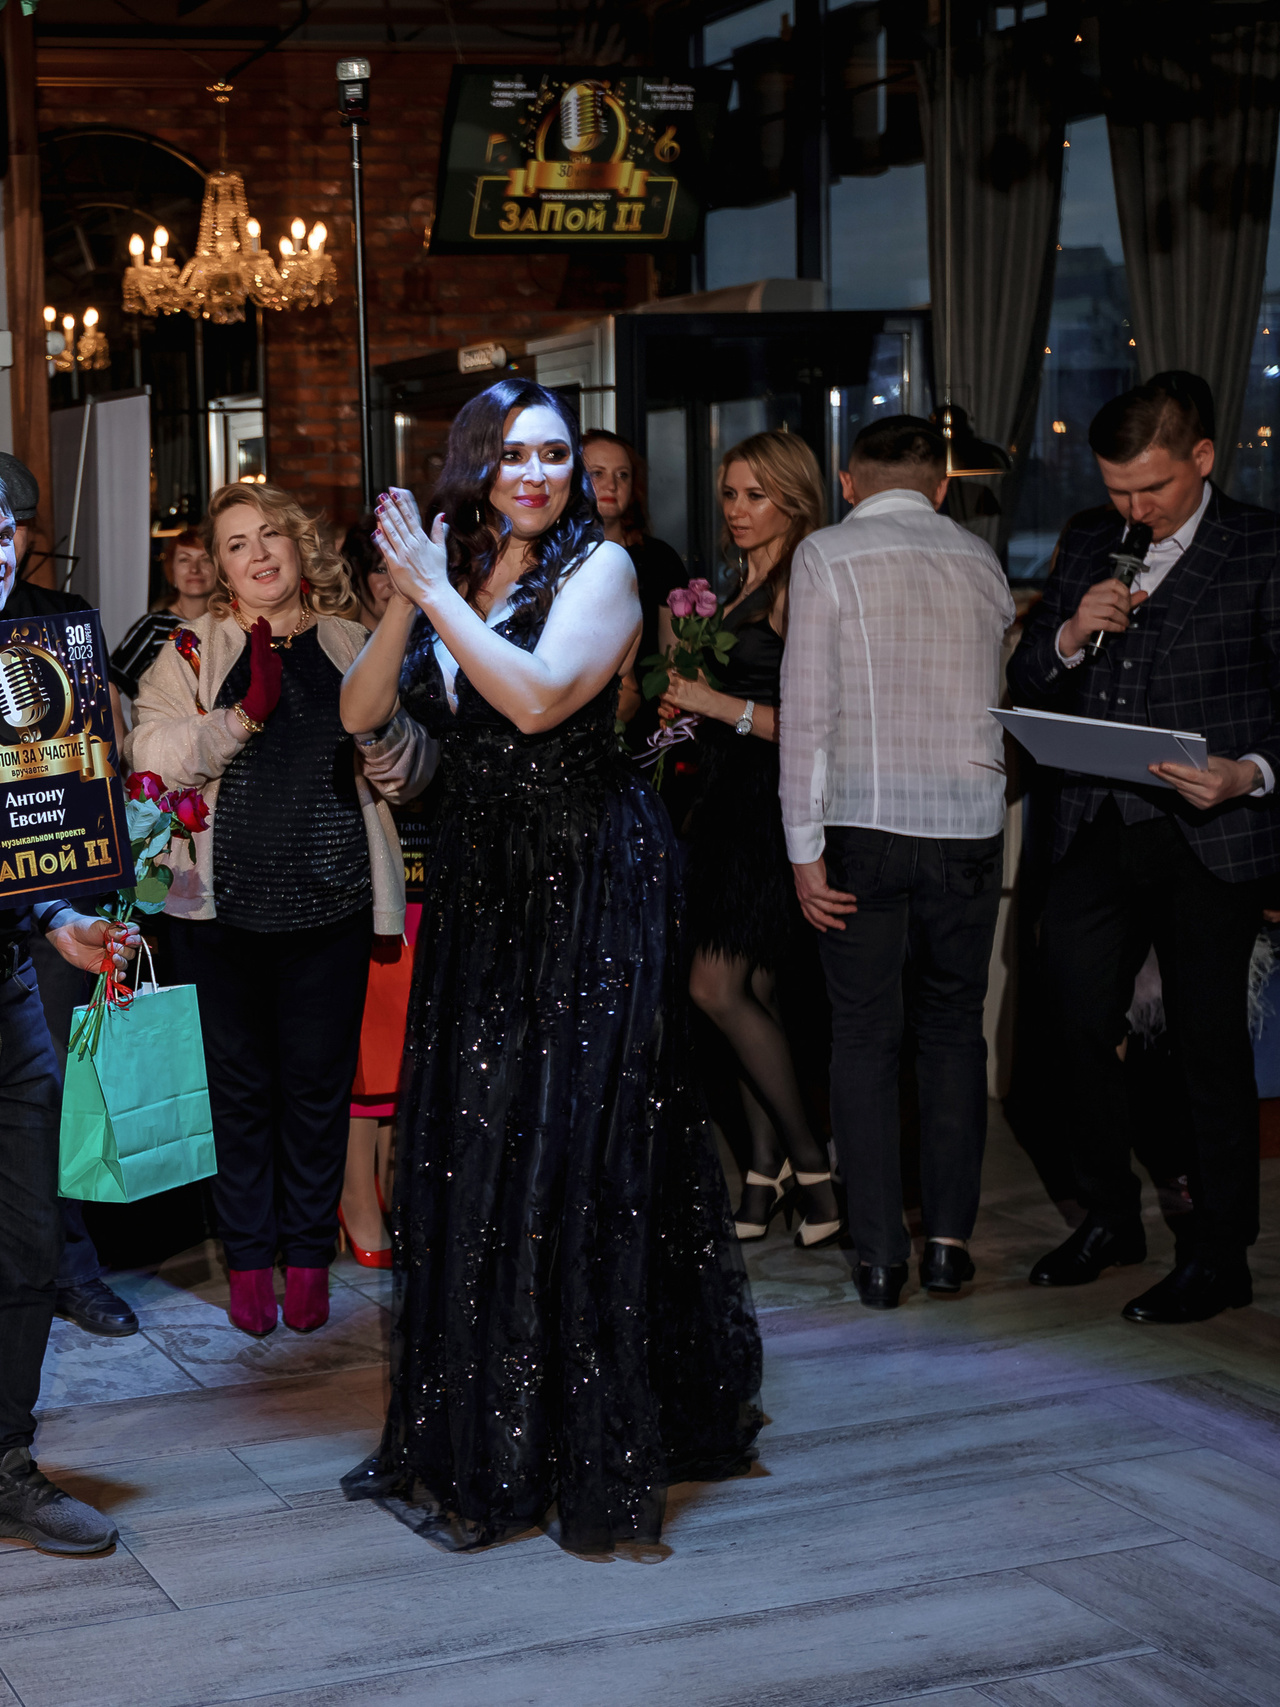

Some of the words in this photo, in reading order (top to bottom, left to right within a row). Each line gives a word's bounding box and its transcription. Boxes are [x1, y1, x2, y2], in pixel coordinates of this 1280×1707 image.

[65, 624, 85, 646] 30
[67, 644, 94, 661] 2023
[22, 748, 37, 764] ЗА
[38, 741, 86, 762] УЧАСТИЕ
[11, 764, 49, 778] вручается
[5, 788, 65, 809] Антону
[9, 808, 66, 828] Евсину
[1, 833, 54, 850] музыкальном
[55, 828, 86, 840] проекте
[84, 838, 112, 867] II
